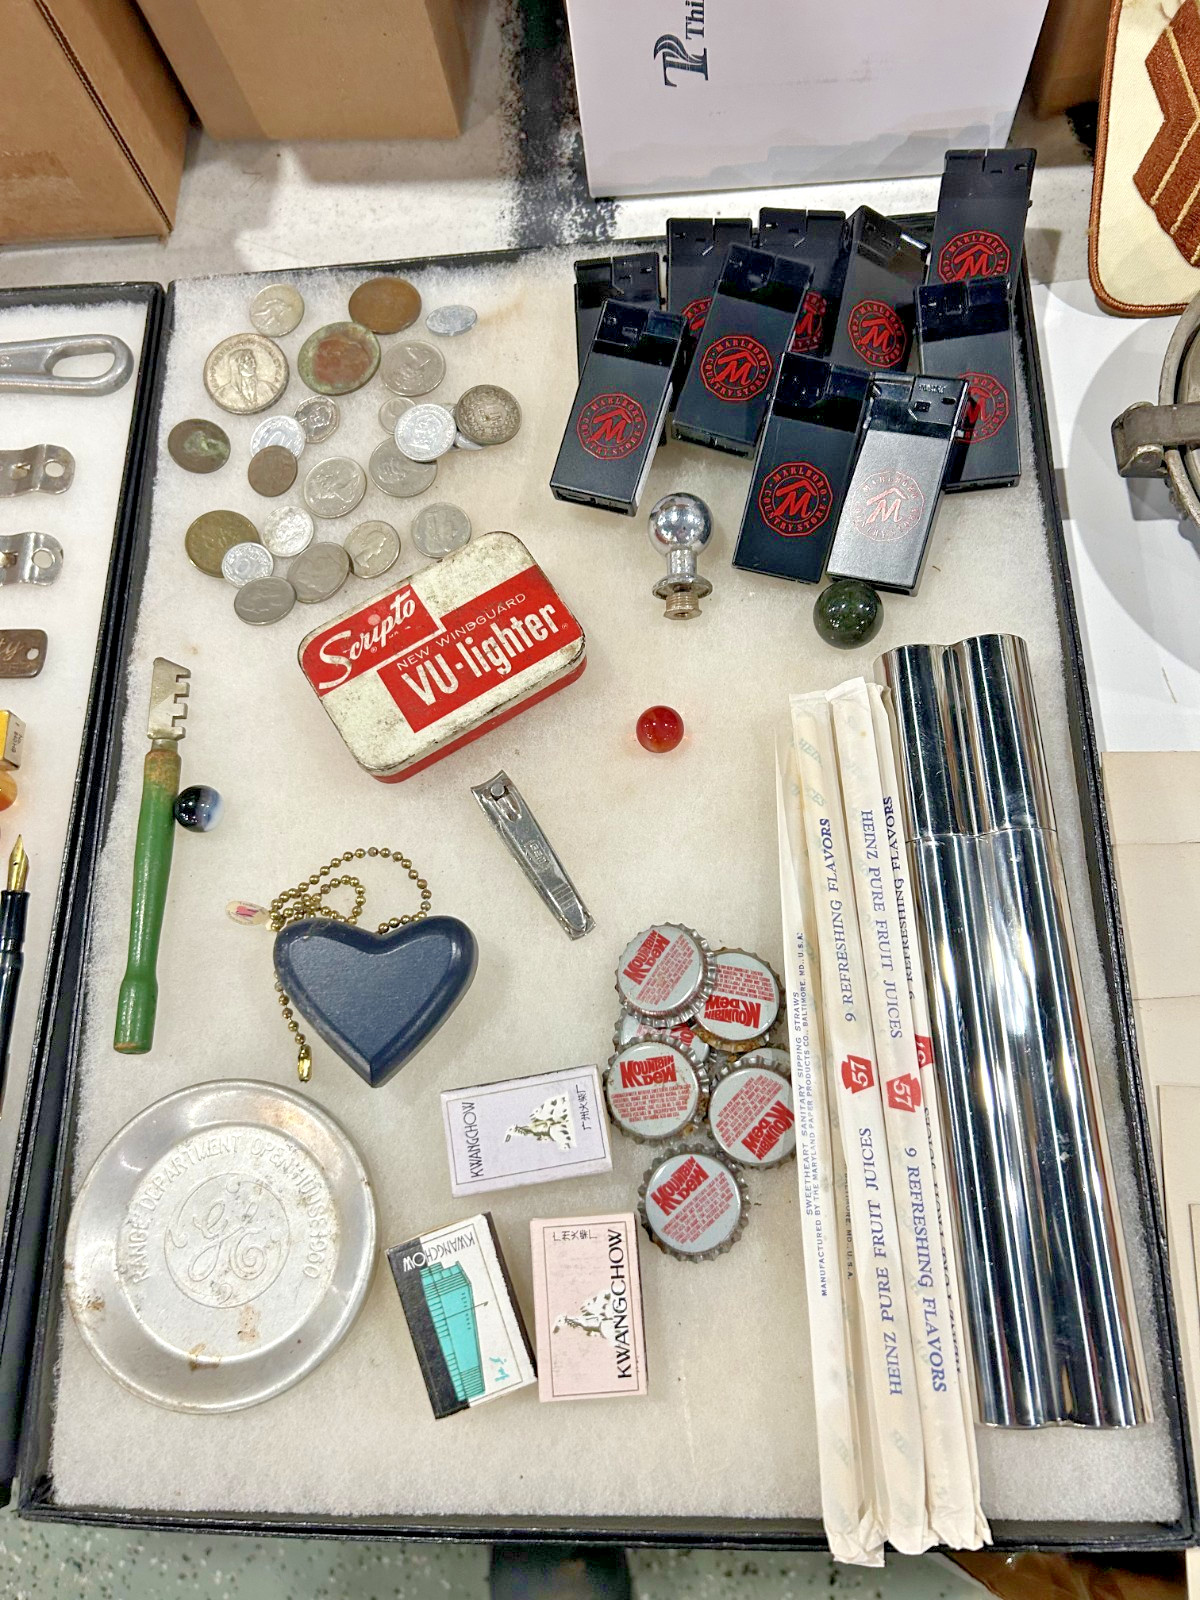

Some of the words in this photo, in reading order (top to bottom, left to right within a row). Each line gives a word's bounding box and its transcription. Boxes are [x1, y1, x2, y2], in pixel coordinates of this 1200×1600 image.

[948, 234, 1003, 254] MARLBORO
[860, 304, 902, 337] MARLBORO
[716, 338, 767, 367] MARLBORO
[591, 397, 642, 422] MARLBORO
[736, 374, 767, 397] STORE
[973, 377, 1001, 396] BORO
[773, 466, 827, 495] MARLBORO
[797, 504, 827, 532] STORE
[319, 589, 417, 690] Scripto
[396, 646, 430, 671] NEW
[435, 593, 526, 647] WINDGUARD
[819, 818, 839, 892] FLAVORS
[860, 809, 879, 860] HEINZ
[883, 796, 901, 872] FLAVORS
[868, 866, 885, 912] PURE
[830, 899, 854, 1005] REFRESHING
[875, 919, 894, 972] FRUIT
[793, 992, 802, 1032] STRAWS
[845, 1012, 857, 1022] 9
[883, 980, 903, 1039] JUICES
[795, 1037, 804, 1078] SIPPING
[803, 1048, 812, 1097] PRODUCTS
[852, 1058, 869, 1088] 57
[798, 1083, 808, 1136] SANITARY
[807, 1100, 815, 1129] PAPER
[893, 1078, 913, 1108] 57
[250, 1137, 298, 1174] OPEN
[461, 1101, 484, 1179] KWANGCHOW
[809, 1132, 819, 1187] MARYLAND
[859, 1127, 879, 1191] JUICES
[904, 1147, 917, 1158] 9
[139, 1134, 242, 1212] DEPARTMENT
[801, 1142, 813, 1216] SWEETHEART
[552, 1228, 598, 1242] 广州火柴厂
[815, 1205, 821, 1216] BY
[867, 1200, 886, 1259] FRUIT
[907, 1165, 934, 1289] REFRESHING
[128, 1213, 151, 1284] RANGE
[403, 1231, 476, 1272] KWANGCHOW
[815, 1220, 828, 1296] MANUFACTURED
[607, 1229, 632, 1379] KWANGCHOW
[875, 1266, 894, 1323] PURE
[883, 1331, 903, 1395] HEINZ
[922, 1297, 947, 1393] FLAVORS
